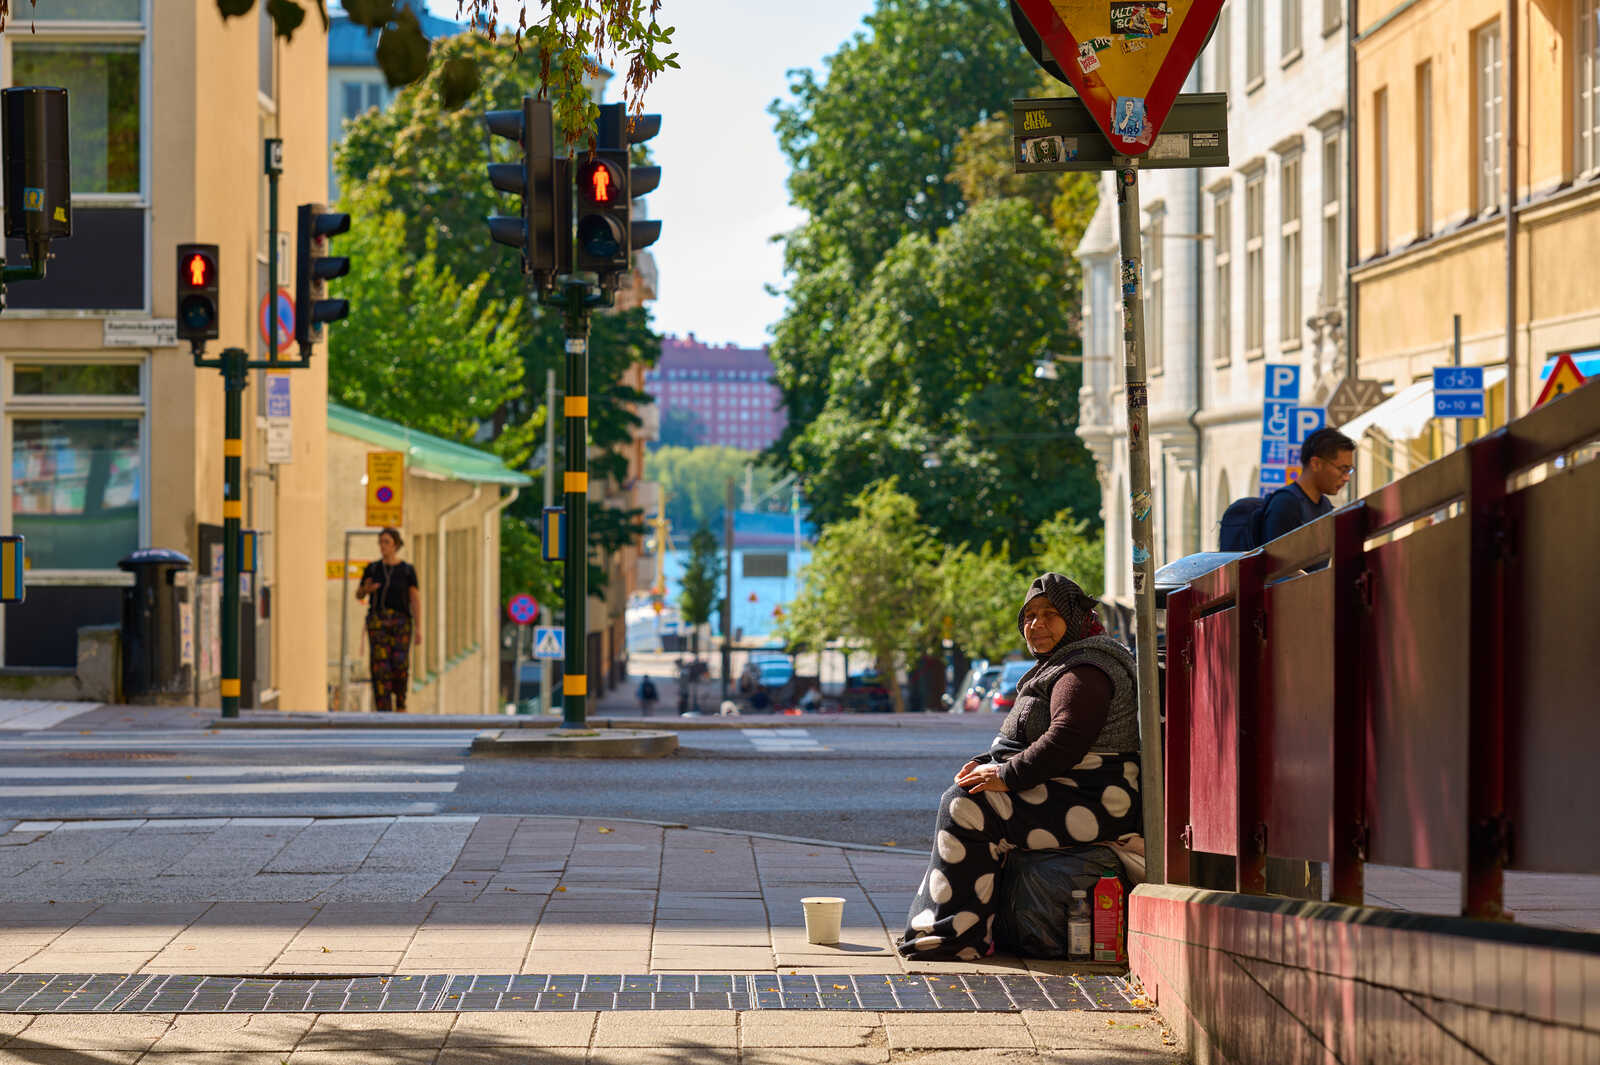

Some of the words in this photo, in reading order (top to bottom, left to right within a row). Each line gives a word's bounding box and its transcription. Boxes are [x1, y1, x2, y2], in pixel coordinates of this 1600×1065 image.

[1272, 367, 1294, 397] P
[1437, 400, 1466, 410] 0-10
[1296, 410, 1319, 442] P
